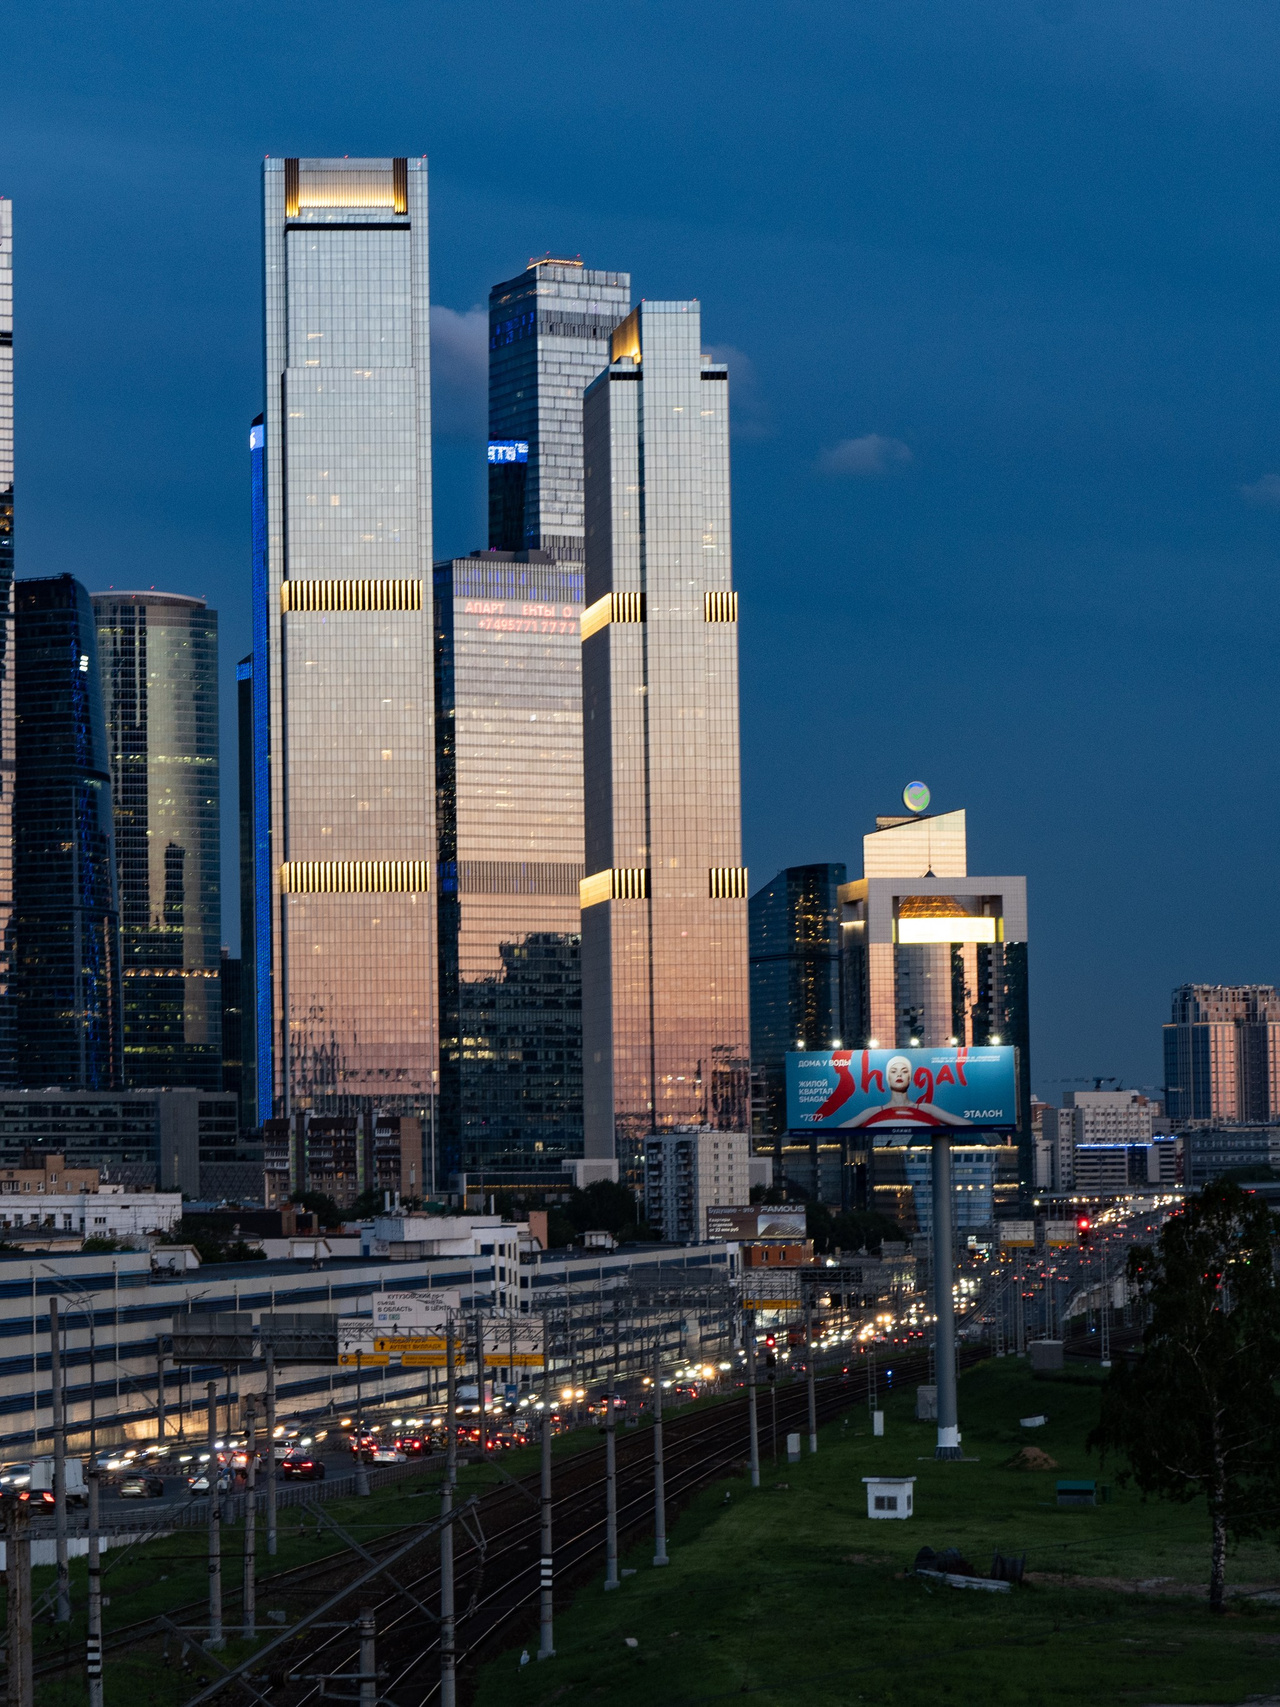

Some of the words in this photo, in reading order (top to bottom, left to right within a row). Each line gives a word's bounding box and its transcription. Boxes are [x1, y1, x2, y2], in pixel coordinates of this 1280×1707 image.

[798, 1060, 820, 1068] ДОМА
[828, 1059, 852, 1067] ВОДЫ
[798, 1079, 828, 1087] ЖИЛОЙ
[799, 1087, 833, 1095] КВАРТАЛ
[963, 1109, 1003, 1118] ЭТАЛОН
[760, 1205, 805, 1213] FAMOUS
